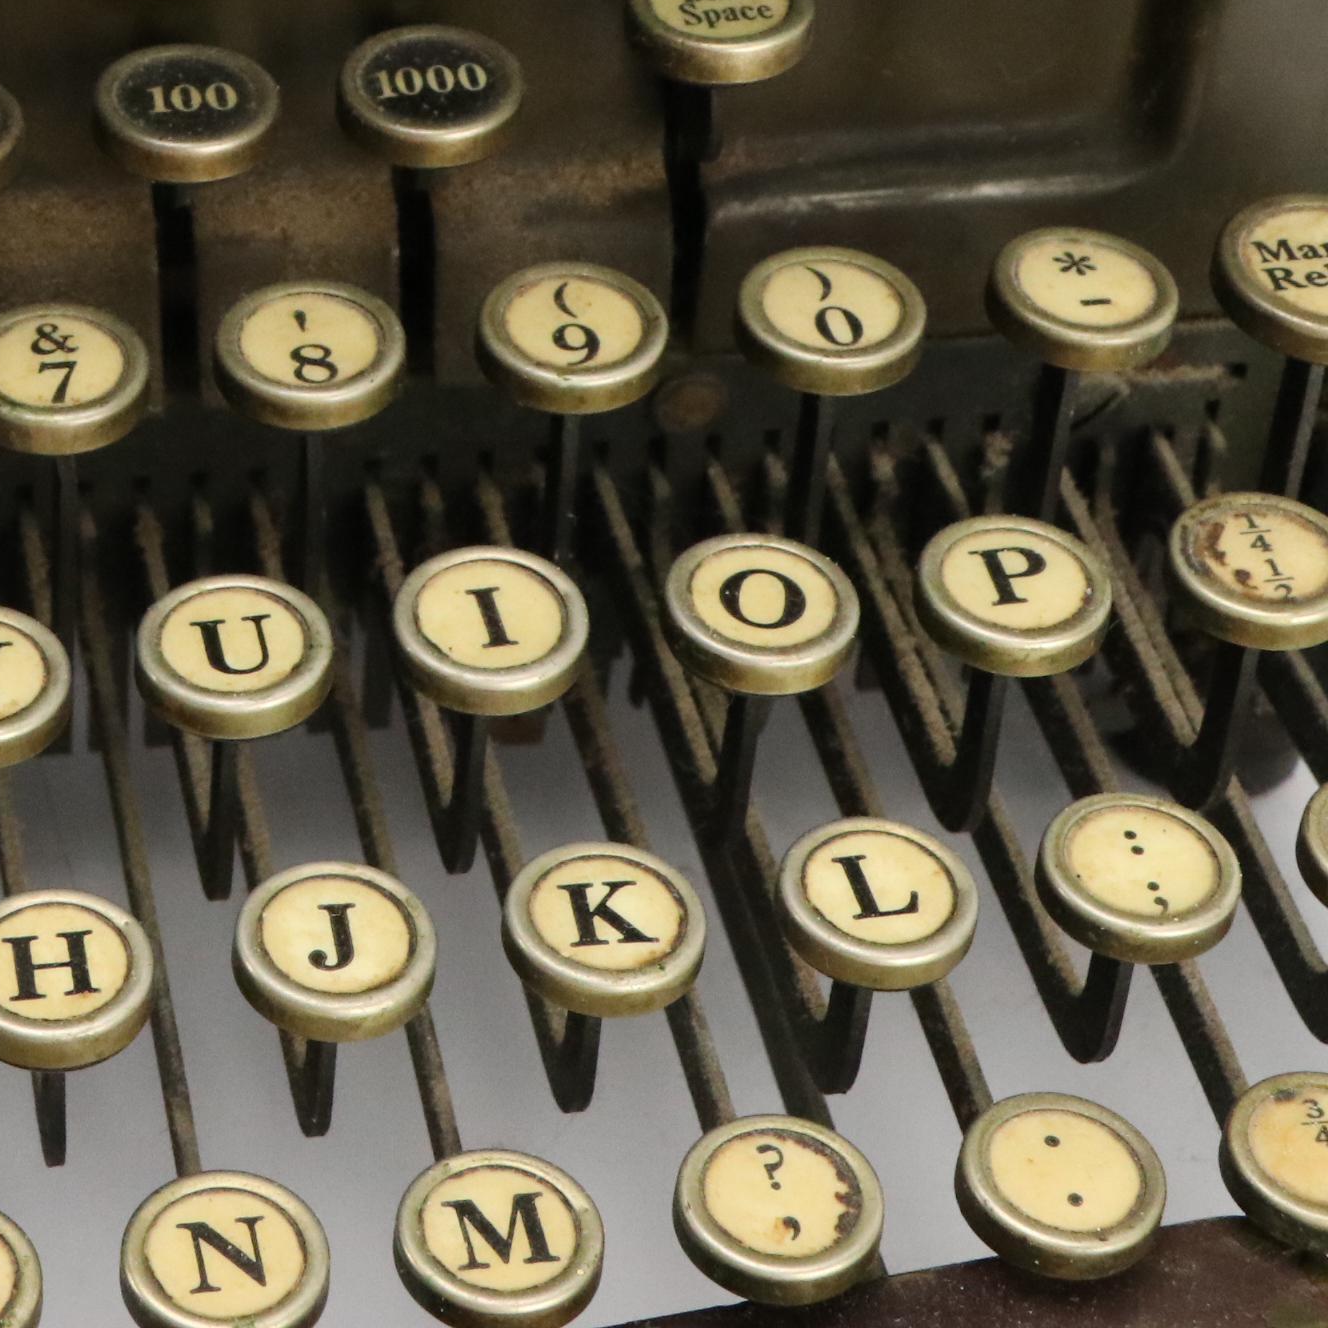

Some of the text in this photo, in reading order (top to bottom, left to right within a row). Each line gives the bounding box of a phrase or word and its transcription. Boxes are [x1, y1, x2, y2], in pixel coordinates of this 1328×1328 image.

[148, 83, 237, 112] 100
[377, 64, 487, 99] 1000
[1262, 264, 1328, 290] Re
[31, 324, 77, 355] &
[552, 323, 600, 366] 9
[814, 305, 864, 347] 0
[39, 361, 77, 404] 7
[289, 344, 339, 384] 8
[719, 569, 806, 629] O
[969, 547, 1046, 606] P
[190, 615, 270, 674] U
[466, 587, 518, 648] I
[559, 879, 659, 947] K
[832, 855, 918, 920] L
[2, 930, 100, 1001] H
[308, 903, 355, 971] J
[756, 1143, 786, 1191] ?
[176, 1216, 266, 1294] N
[442, 1191, 561, 1271] M
